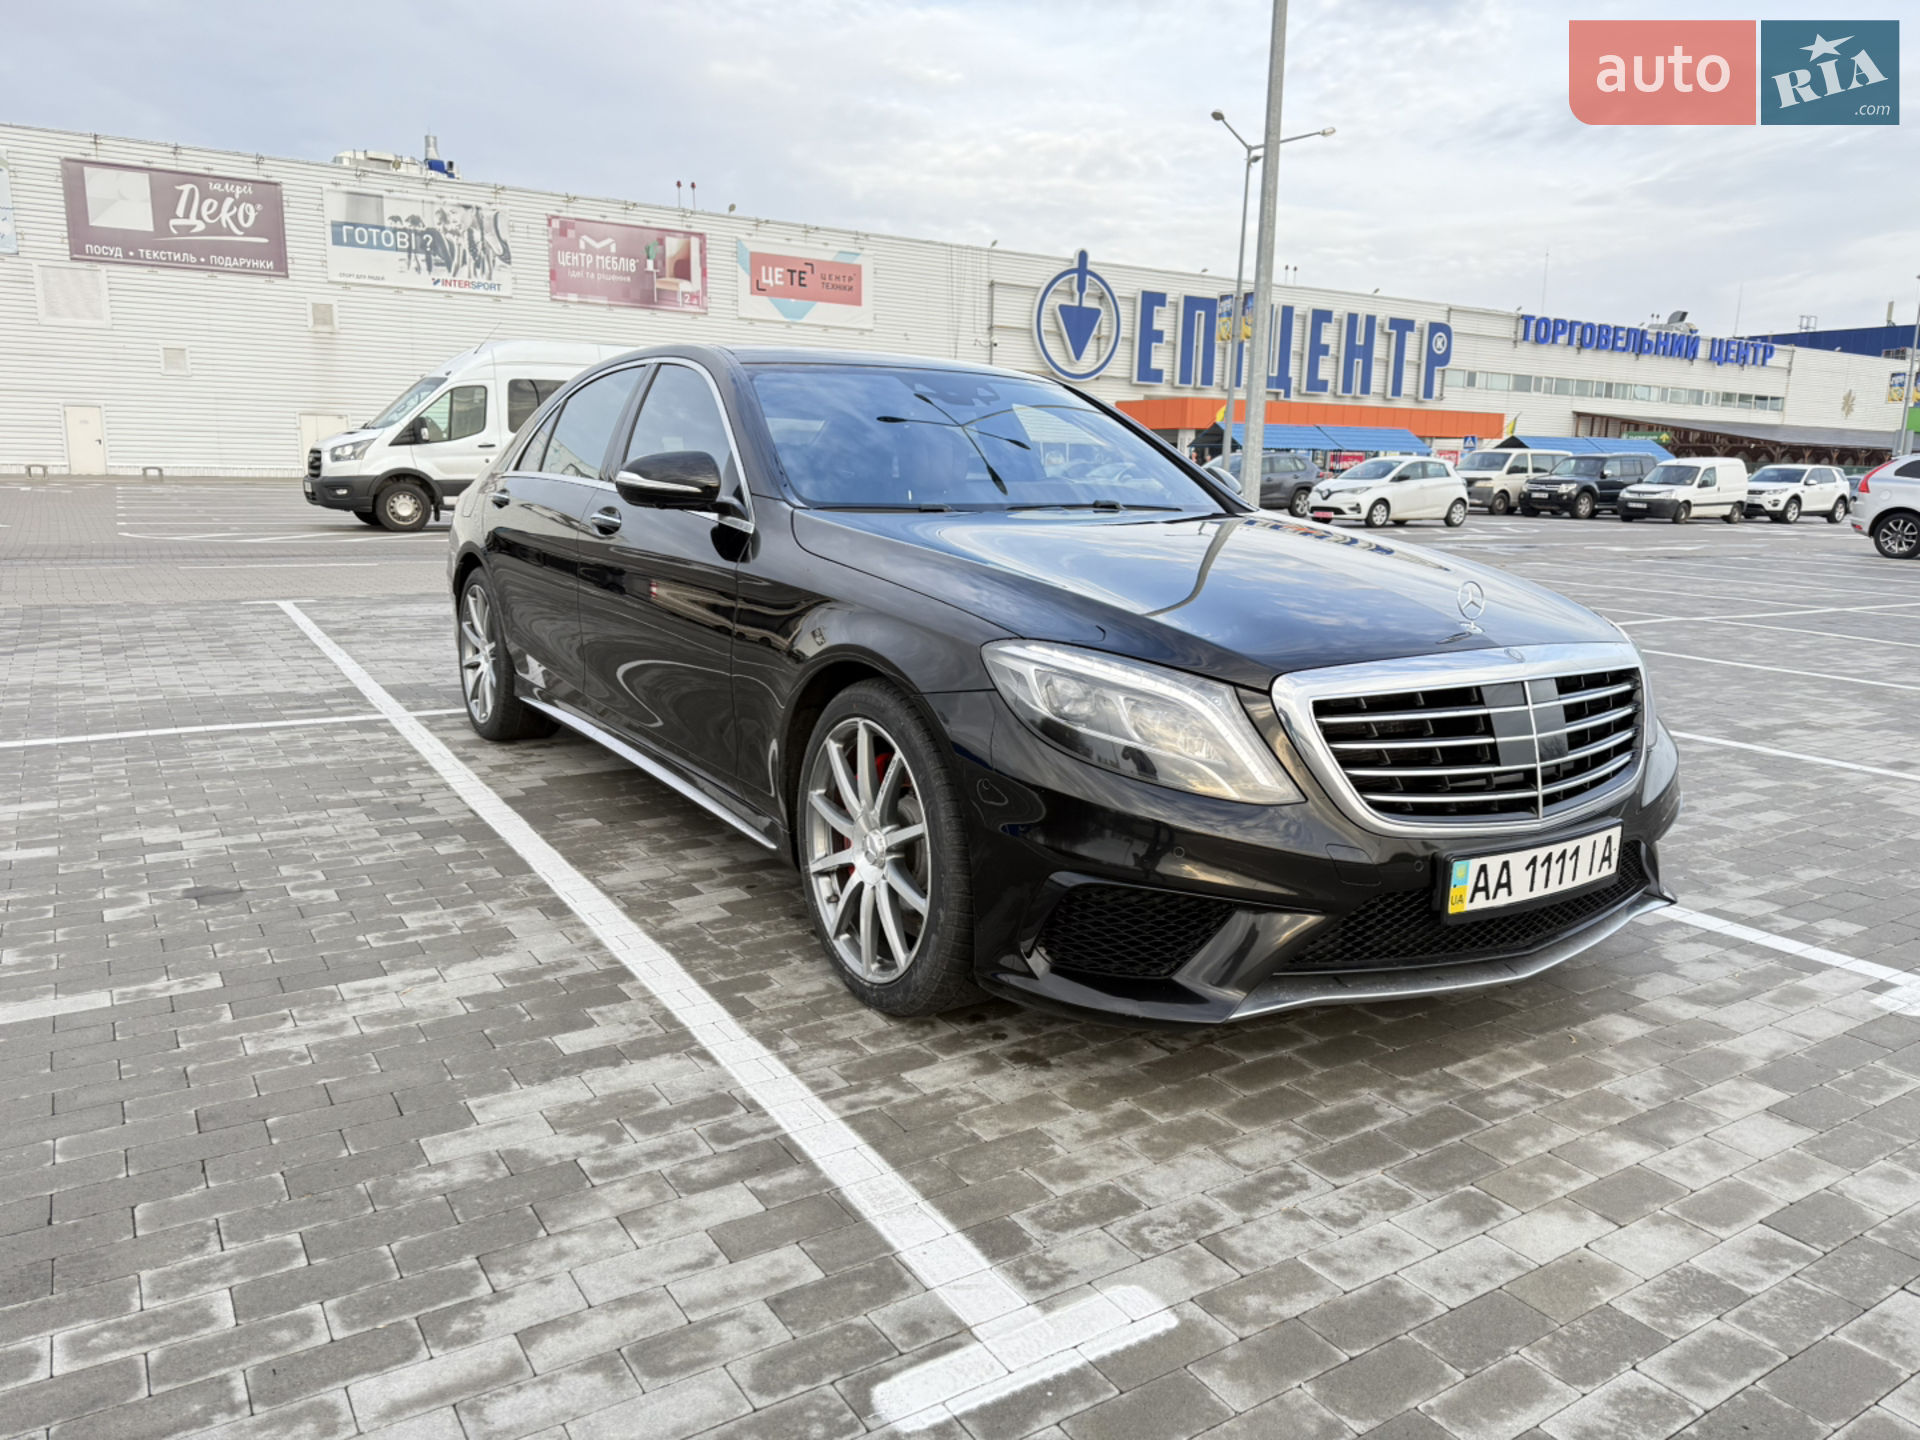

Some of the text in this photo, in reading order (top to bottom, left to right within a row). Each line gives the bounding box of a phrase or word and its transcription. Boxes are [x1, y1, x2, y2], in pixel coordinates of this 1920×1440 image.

[342, 225, 415, 250] ГОТОВІ
[85, 244, 274, 270] ПОСУД ТЕКСТИЛЬ ПОДАРУНКИ
[557, 250, 637, 273] ЦЕНТР МЕБЛІВ
[441, 278, 502, 292] INTERSPORT
[820, 273, 854, 283] ЦЕНТР
[821, 282, 854, 292] ТЕХНІКИ
[1521, 314, 1776, 366] ТОРГОВЕЛЬНИЙ ЦЕНТР
[1469, 859, 1512, 904] AA
[1525, 845, 1581, 892] 1111
[1450, 894, 1464, 906] UA
